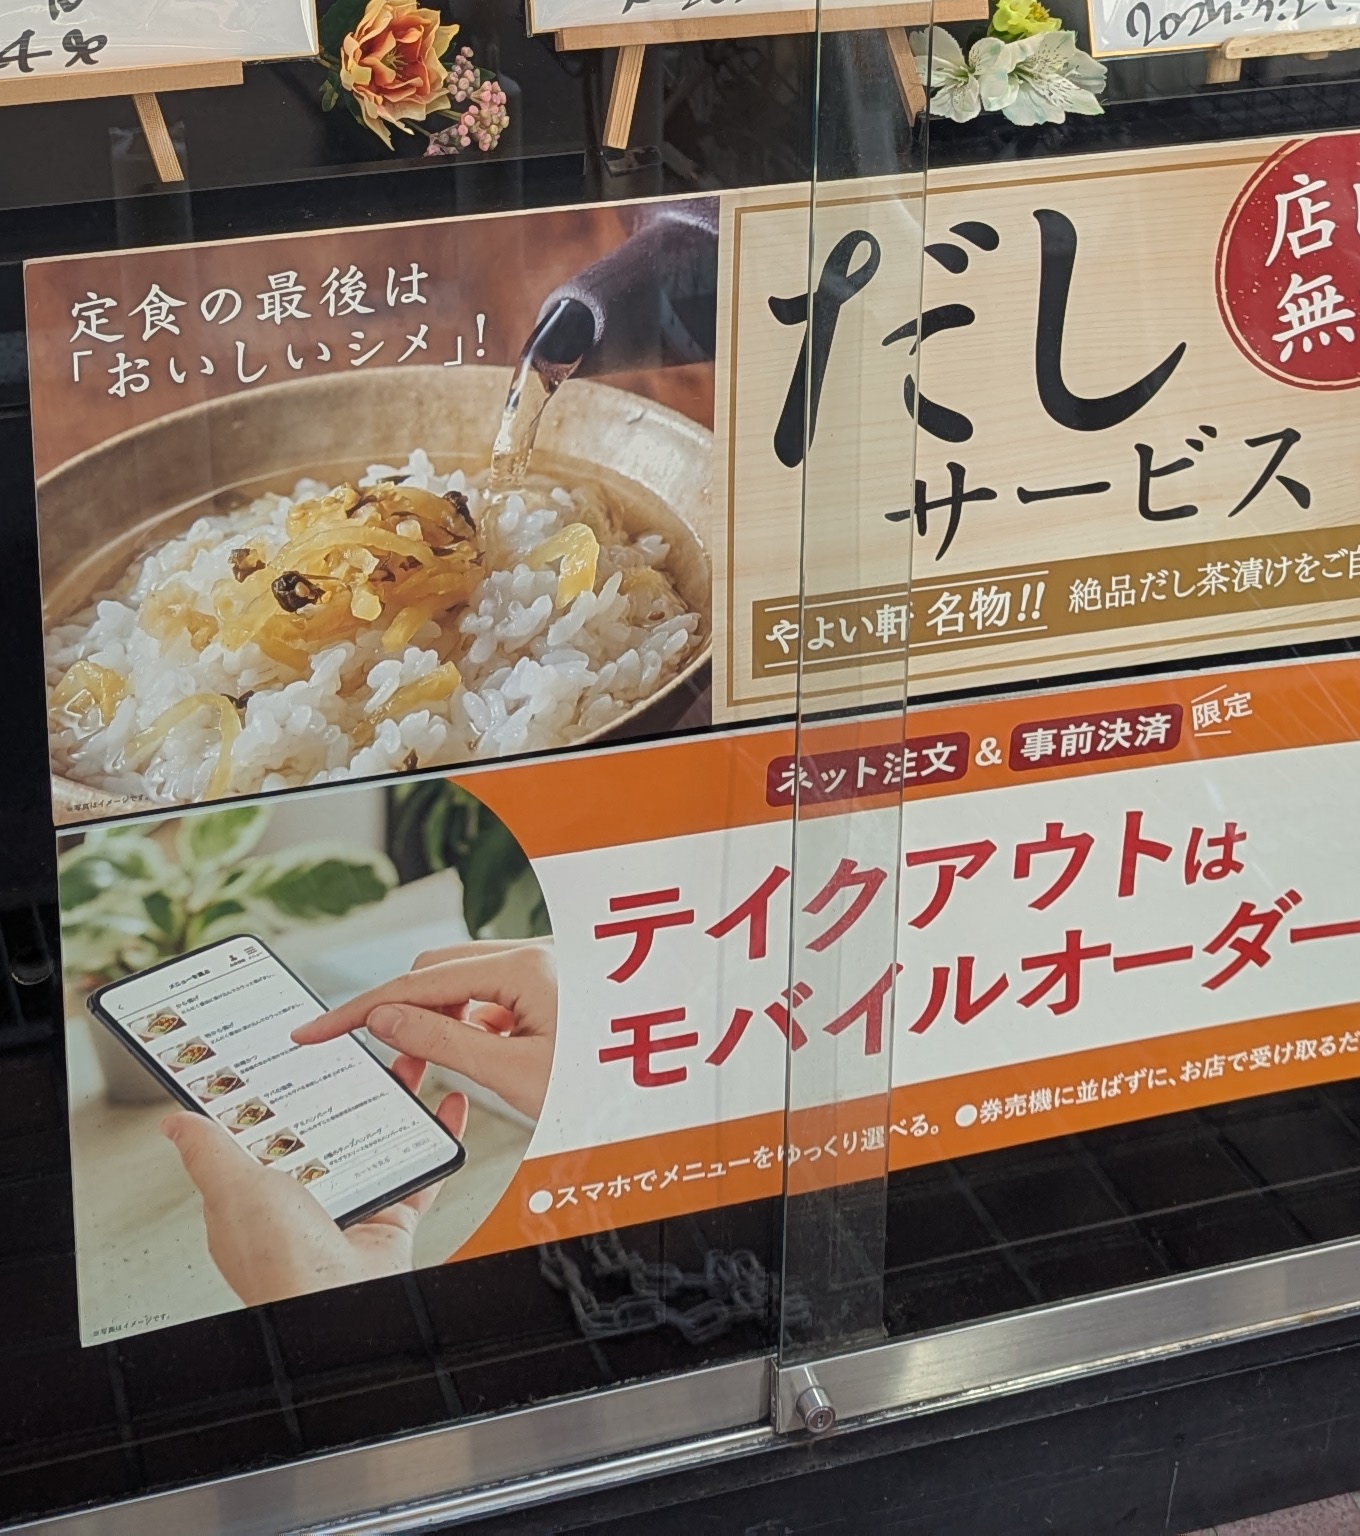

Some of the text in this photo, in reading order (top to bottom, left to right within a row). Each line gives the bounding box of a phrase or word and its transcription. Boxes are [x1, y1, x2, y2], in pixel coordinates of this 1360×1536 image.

[68, 263, 430, 345] 定食の最後は
[70, 313, 487, 398] 「おいしいシメ」!
[767, 208, 1187, 470] だし
[885, 426, 1313, 563] サービス
[766, 603, 910, 658] やよい軒
[775, 692, 1254, 799] ネット注文 & 事前決済 限定
[593, 809, 1249, 983] テイクアウトは
